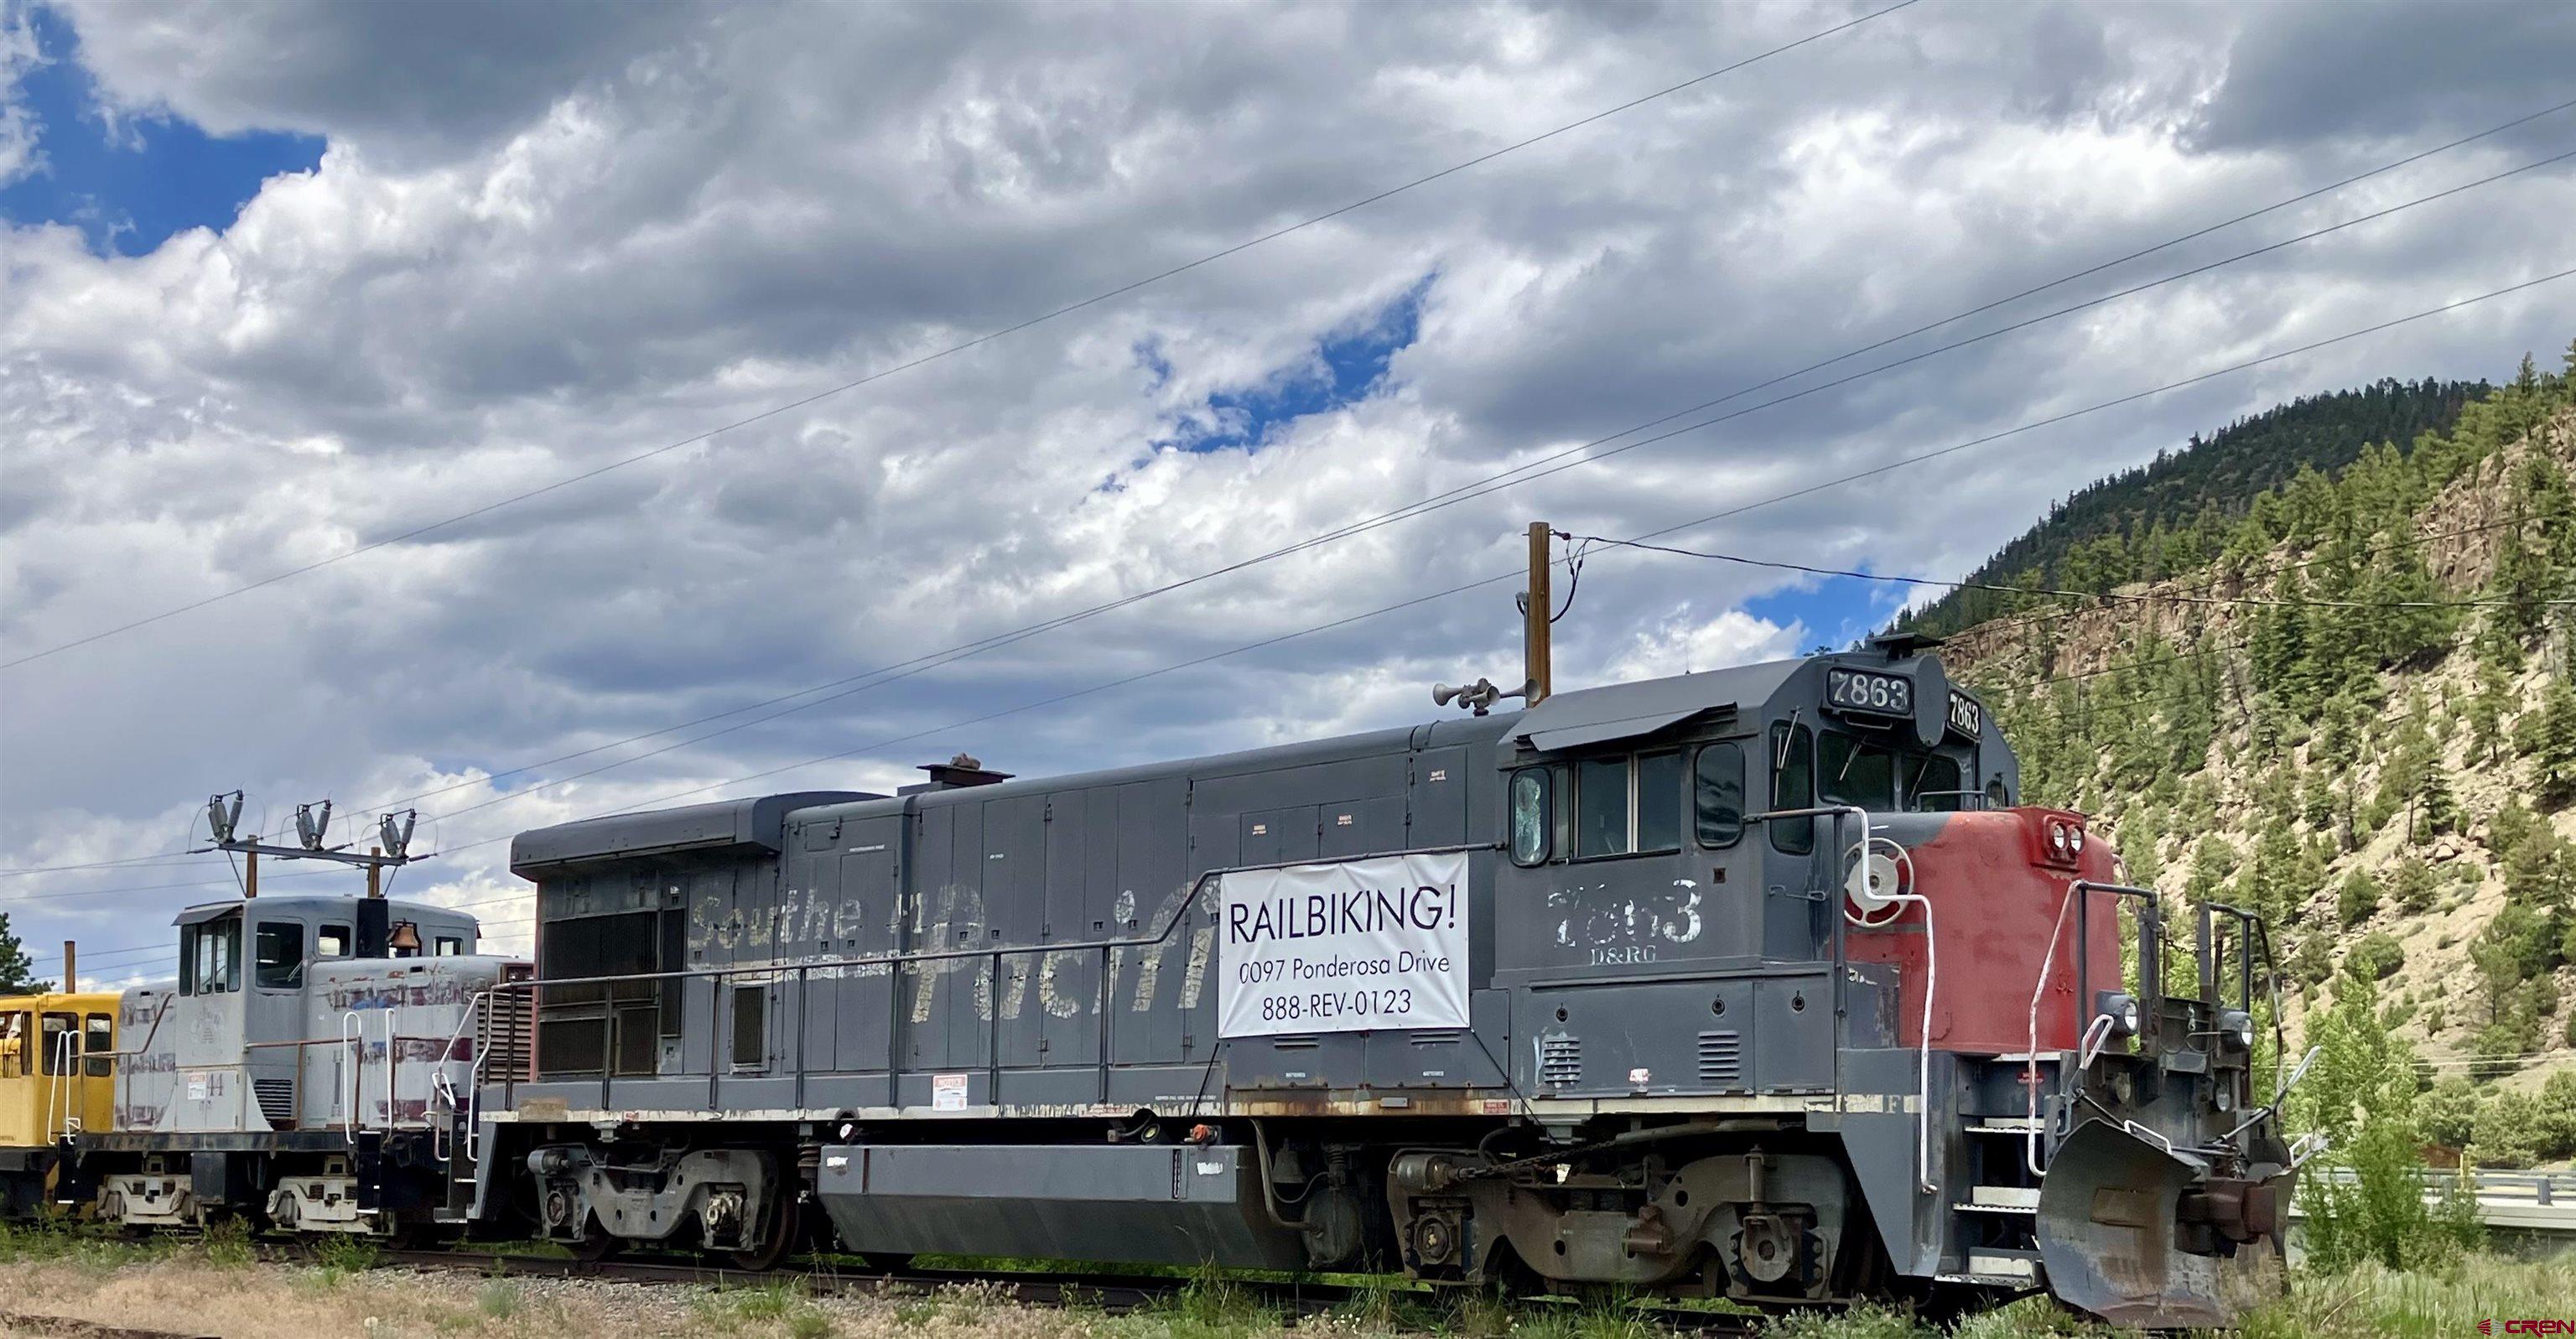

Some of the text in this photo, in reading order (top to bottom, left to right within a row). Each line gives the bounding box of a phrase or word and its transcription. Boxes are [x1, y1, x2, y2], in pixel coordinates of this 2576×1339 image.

[1830, 672, 1909, 711] 7863
[1950, 693, 1980, 734] 7863
[1230, 884, 1456, 944] RAILBIKING!
[1239, 950, 1451, 984] 0097 Ponderosa Drive
[1590, 944, 1657, 966] D&RG
[1262, 989, 1412, 1021] 888-REV-0123
